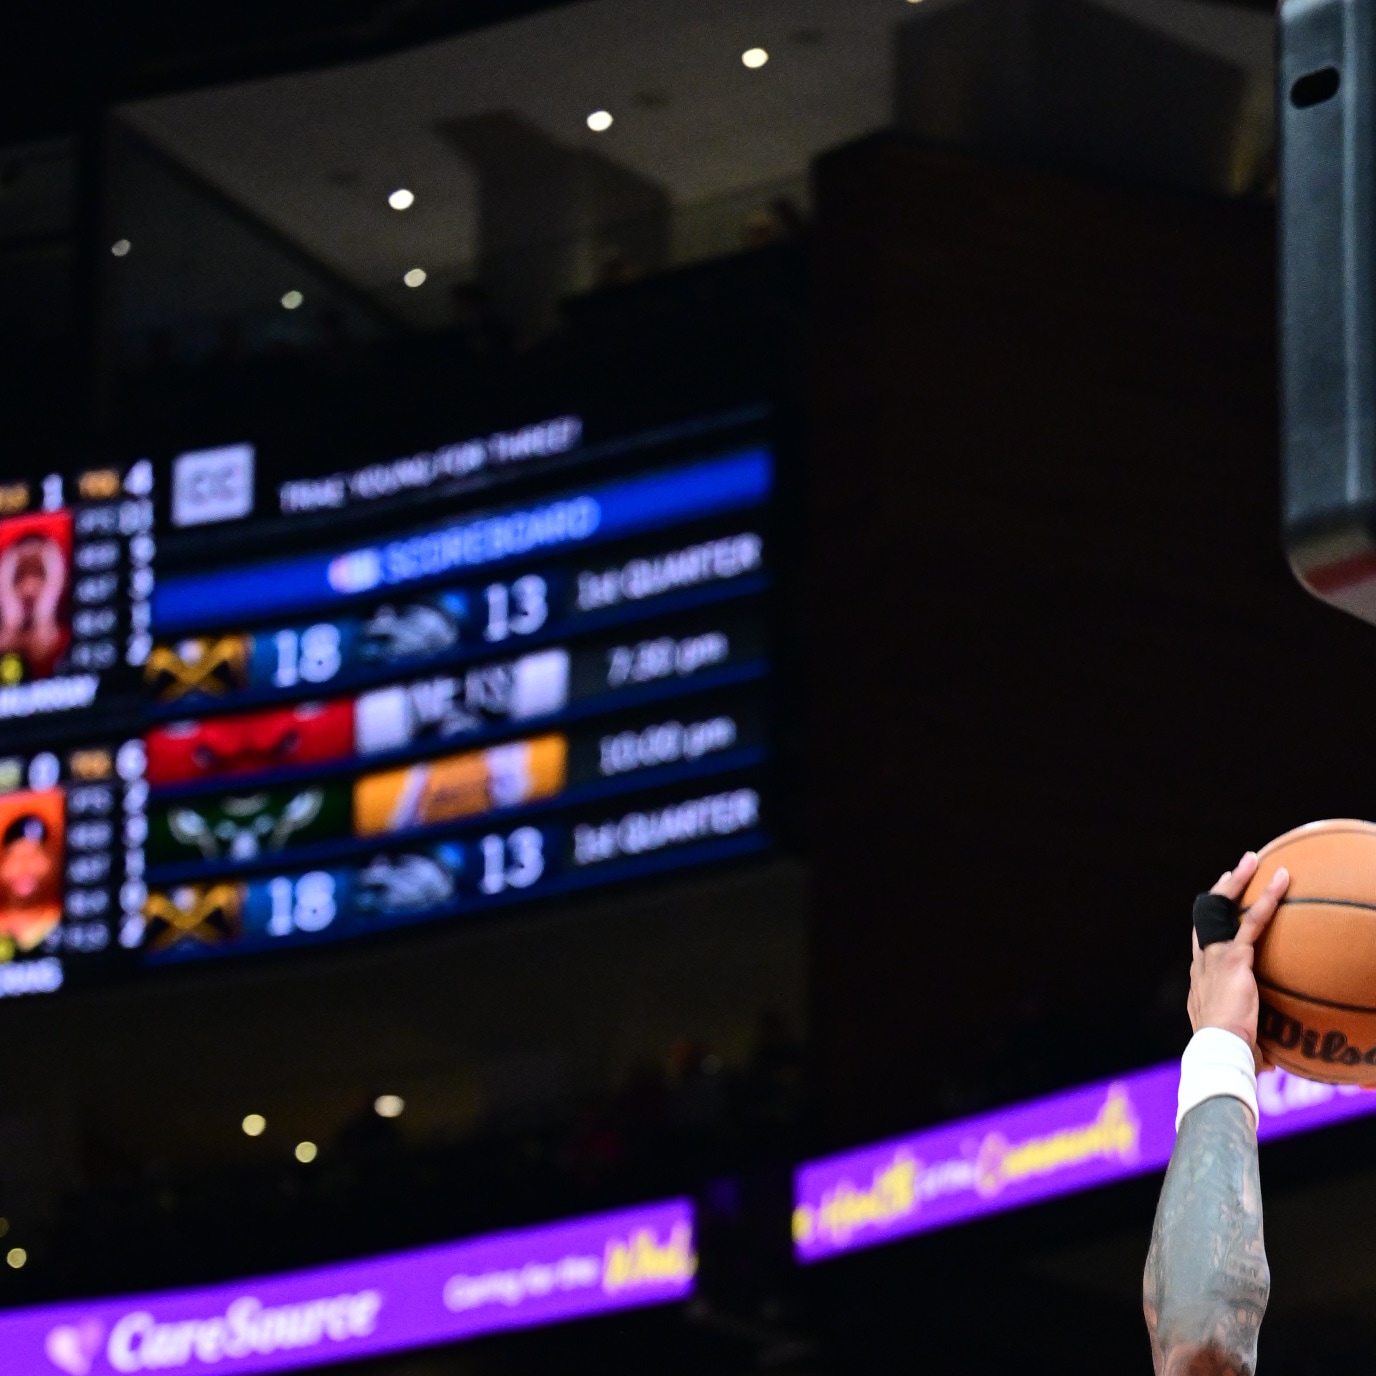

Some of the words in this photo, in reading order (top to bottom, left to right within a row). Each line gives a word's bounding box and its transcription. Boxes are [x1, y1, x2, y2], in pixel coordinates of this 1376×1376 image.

[272, 623, 342, 688] 18
[484, 574, 549, 642] 13
[267, 871, 337, 937] 18
[479, 826, 544, 895] 13
[107, 1290, 384, 1375] CareSource
